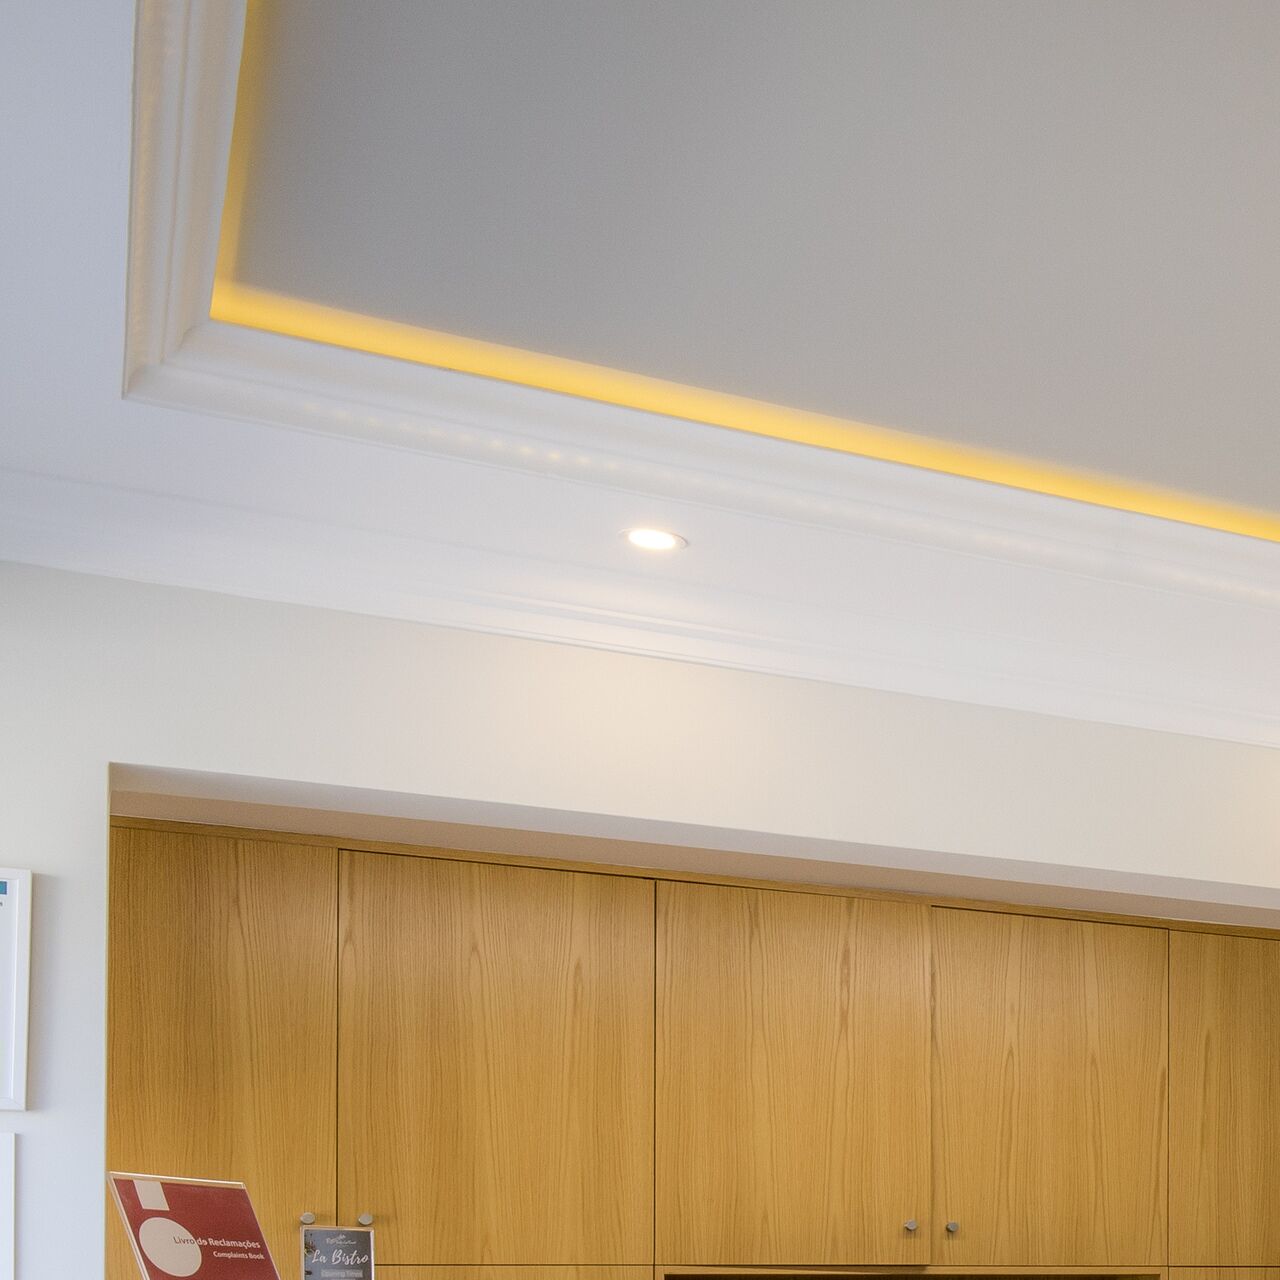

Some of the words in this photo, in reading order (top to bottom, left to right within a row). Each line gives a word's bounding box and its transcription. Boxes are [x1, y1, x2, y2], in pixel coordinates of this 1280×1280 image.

[173, 1235, 196, 1246] Livro
[196, 1236, 208, 1246] de
[208, 1237, 261, 1249] Reclamações
[212, 1250, 249, 1260] Complaints
[248, 1252, 265, 1260] Book
[312, 1249, 328, 1264] La
[332, 1248, 369, 1266] Bistro
